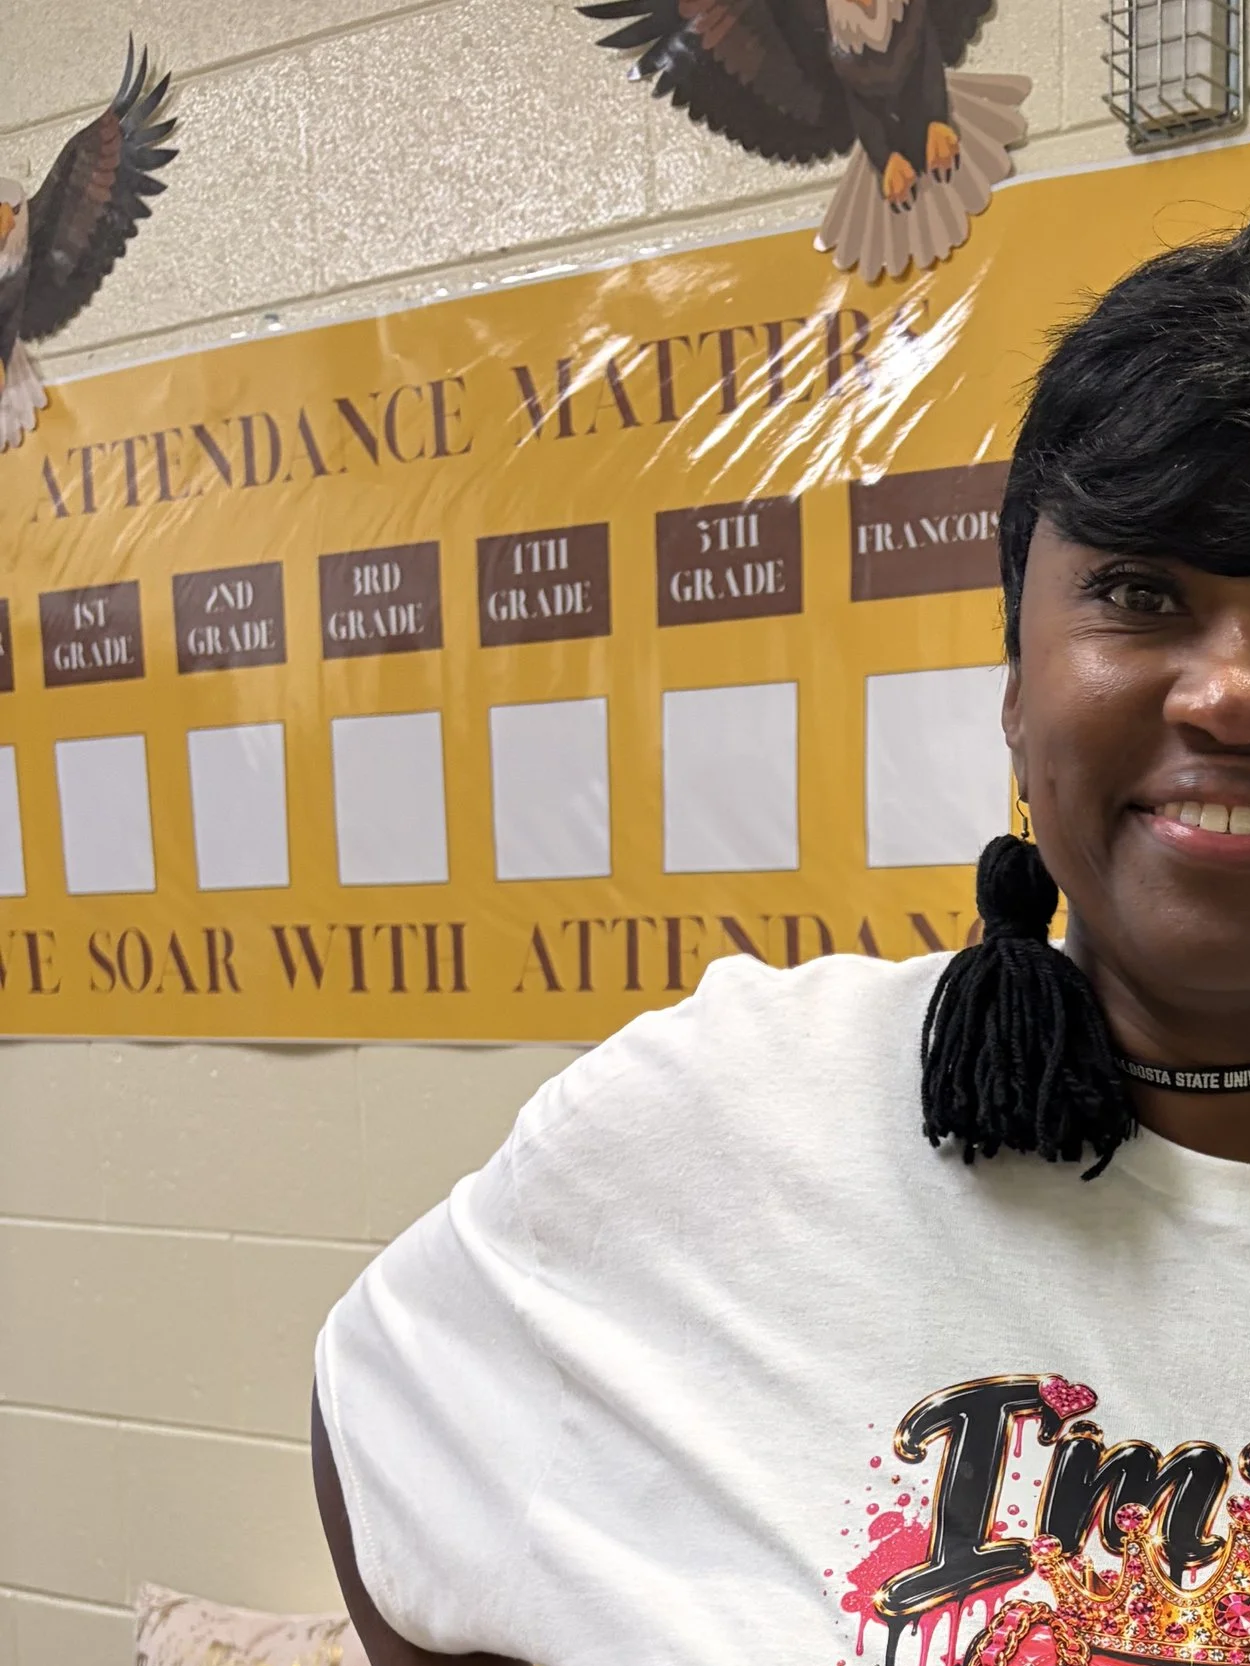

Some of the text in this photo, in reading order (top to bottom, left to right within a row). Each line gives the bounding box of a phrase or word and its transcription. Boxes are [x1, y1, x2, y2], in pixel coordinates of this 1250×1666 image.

[31, 376, 473, 523] ATTENDANCE
[697, 513, 760, 553] 5TH
[205, 580, 254, 613] 2ND
[353, 562, 401, 596] 3RD
[670, 560, 785, 603] GRADE
[73, 598, 109, 631] 1ST
[487, 580, 593, 622] GRADE
[187, 619, 276, 656] GRADE
[327, 602, 424, 640] GRADE
[54, 635, 135, 671] GRADE
[88, 926, 242, 994] SOAR
[270, 922, 470, 993] WITH
[1175, 1072, 1220, 1089] STATE
[874, 1373, 1231, 1607] I'm
